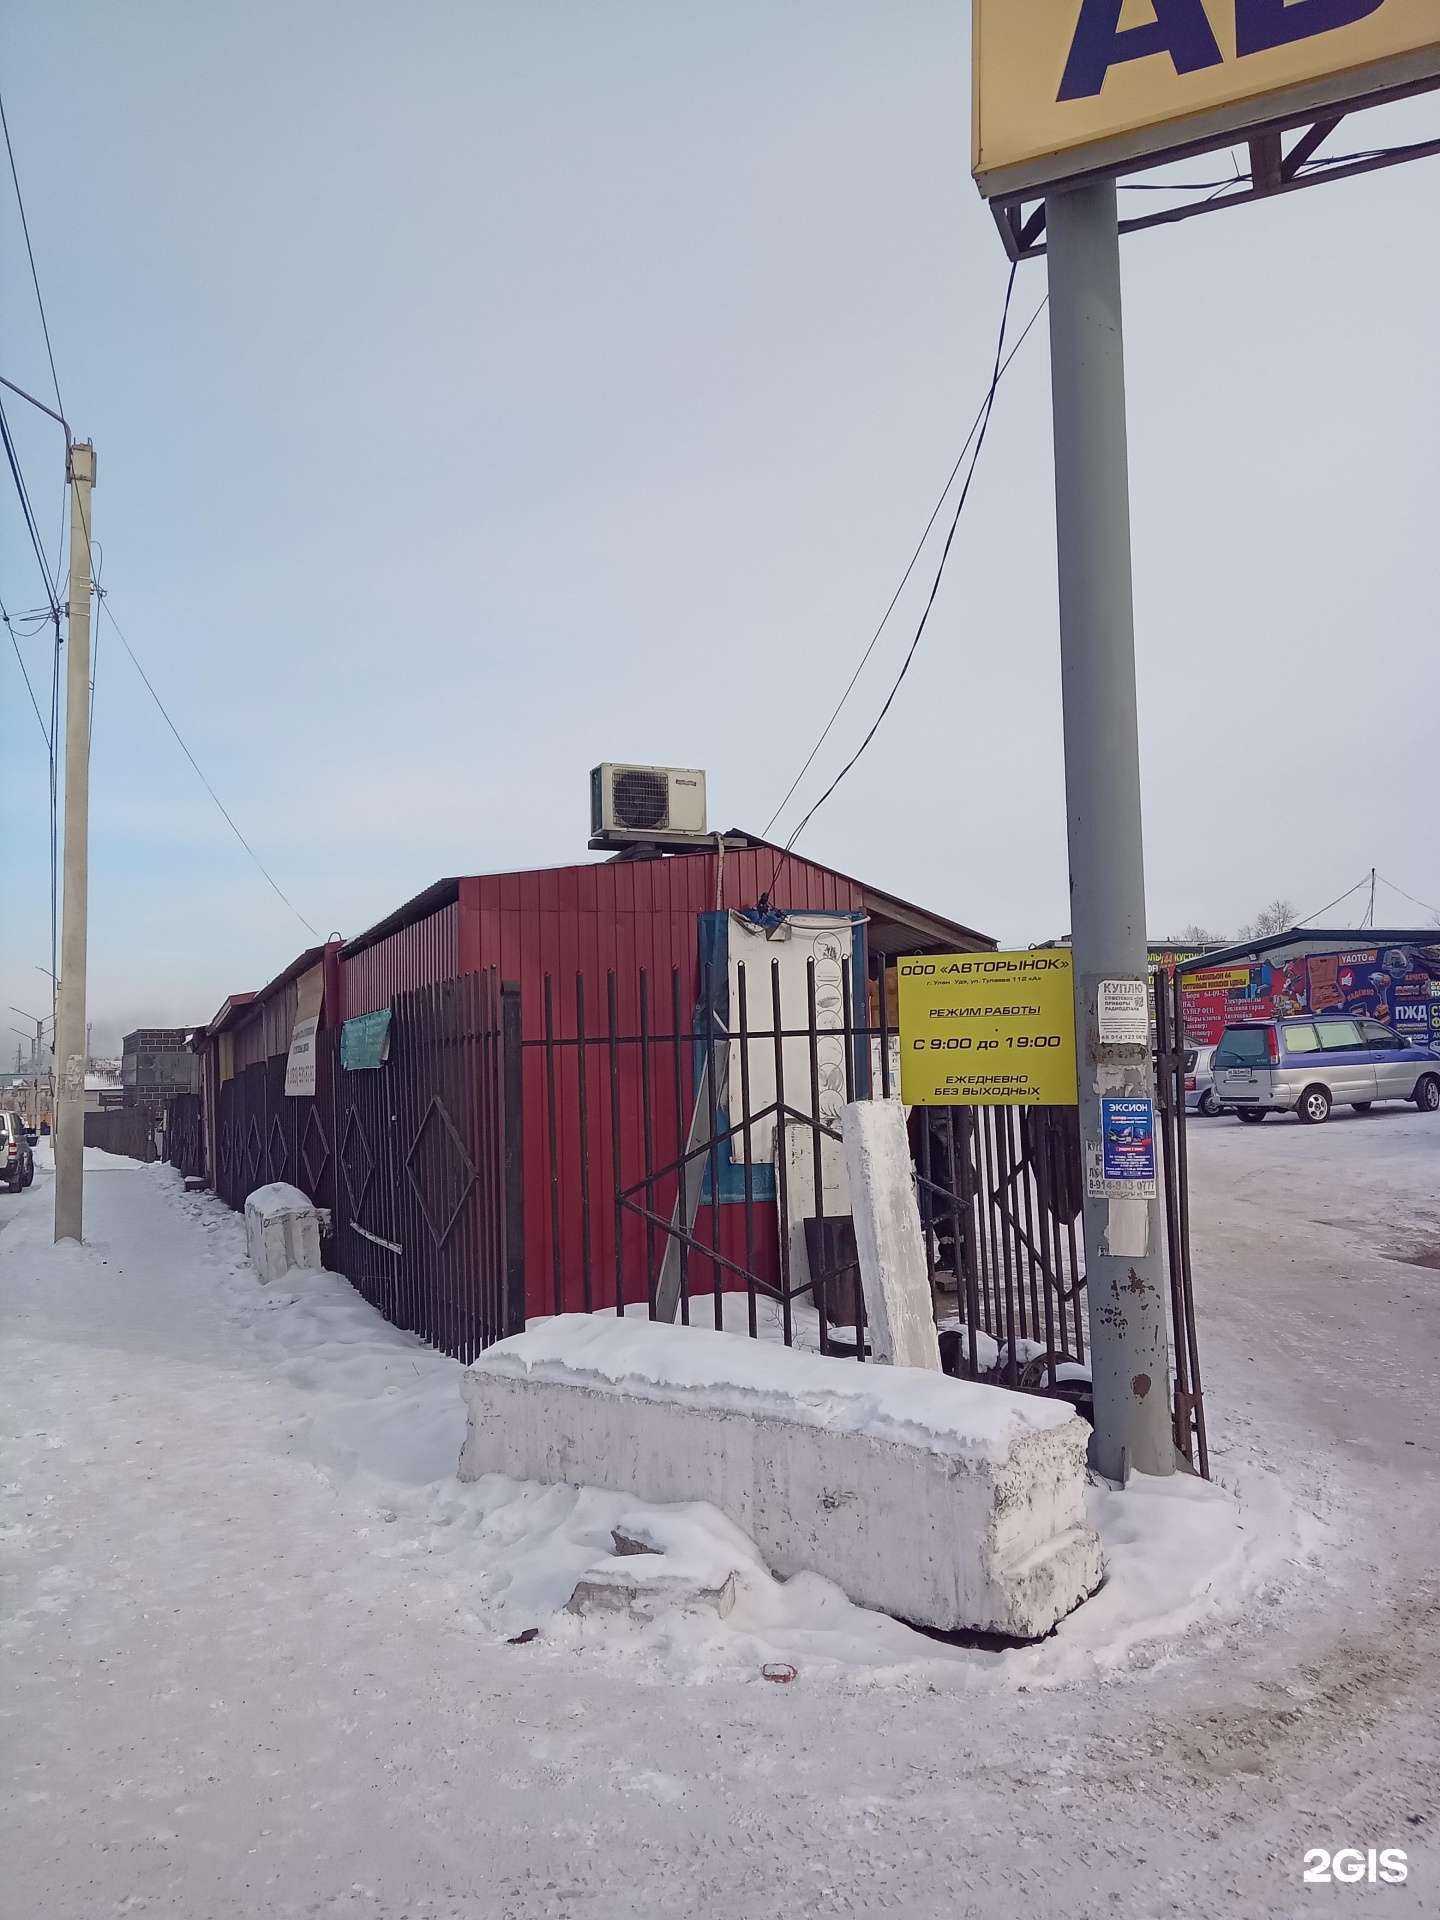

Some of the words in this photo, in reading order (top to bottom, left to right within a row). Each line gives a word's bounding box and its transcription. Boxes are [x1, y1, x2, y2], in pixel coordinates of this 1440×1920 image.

[901, 964, 935, 976] ООО
[940, 958, 1069, 974] «АВТОРЫНОК»
[1103, 982, 1143, 994] КУПЛЮ
[929, 1007, 982, 1018] РЕЖИМ
[984, 1006, 1041, 1016] РАБОТЫ
[1395, 1005, 1428, 1020] ПЖД
[913, 1039, 926, 1050] С
[930, 1038, 972, 1050] 9:00
[976, 1040, 999, 1050] до
[1005, 1036, 1061, 1048] 19:00
[945, 1075, 1028, 1084] ЕЖЕДНЕВНО
[934, 1088, 959, 1096] БЕЗ
[962, 1087, 1040, 1096] ВЫХОДНЫХ
[1108, 1104, 1148, 1112] ЭКСИОН
